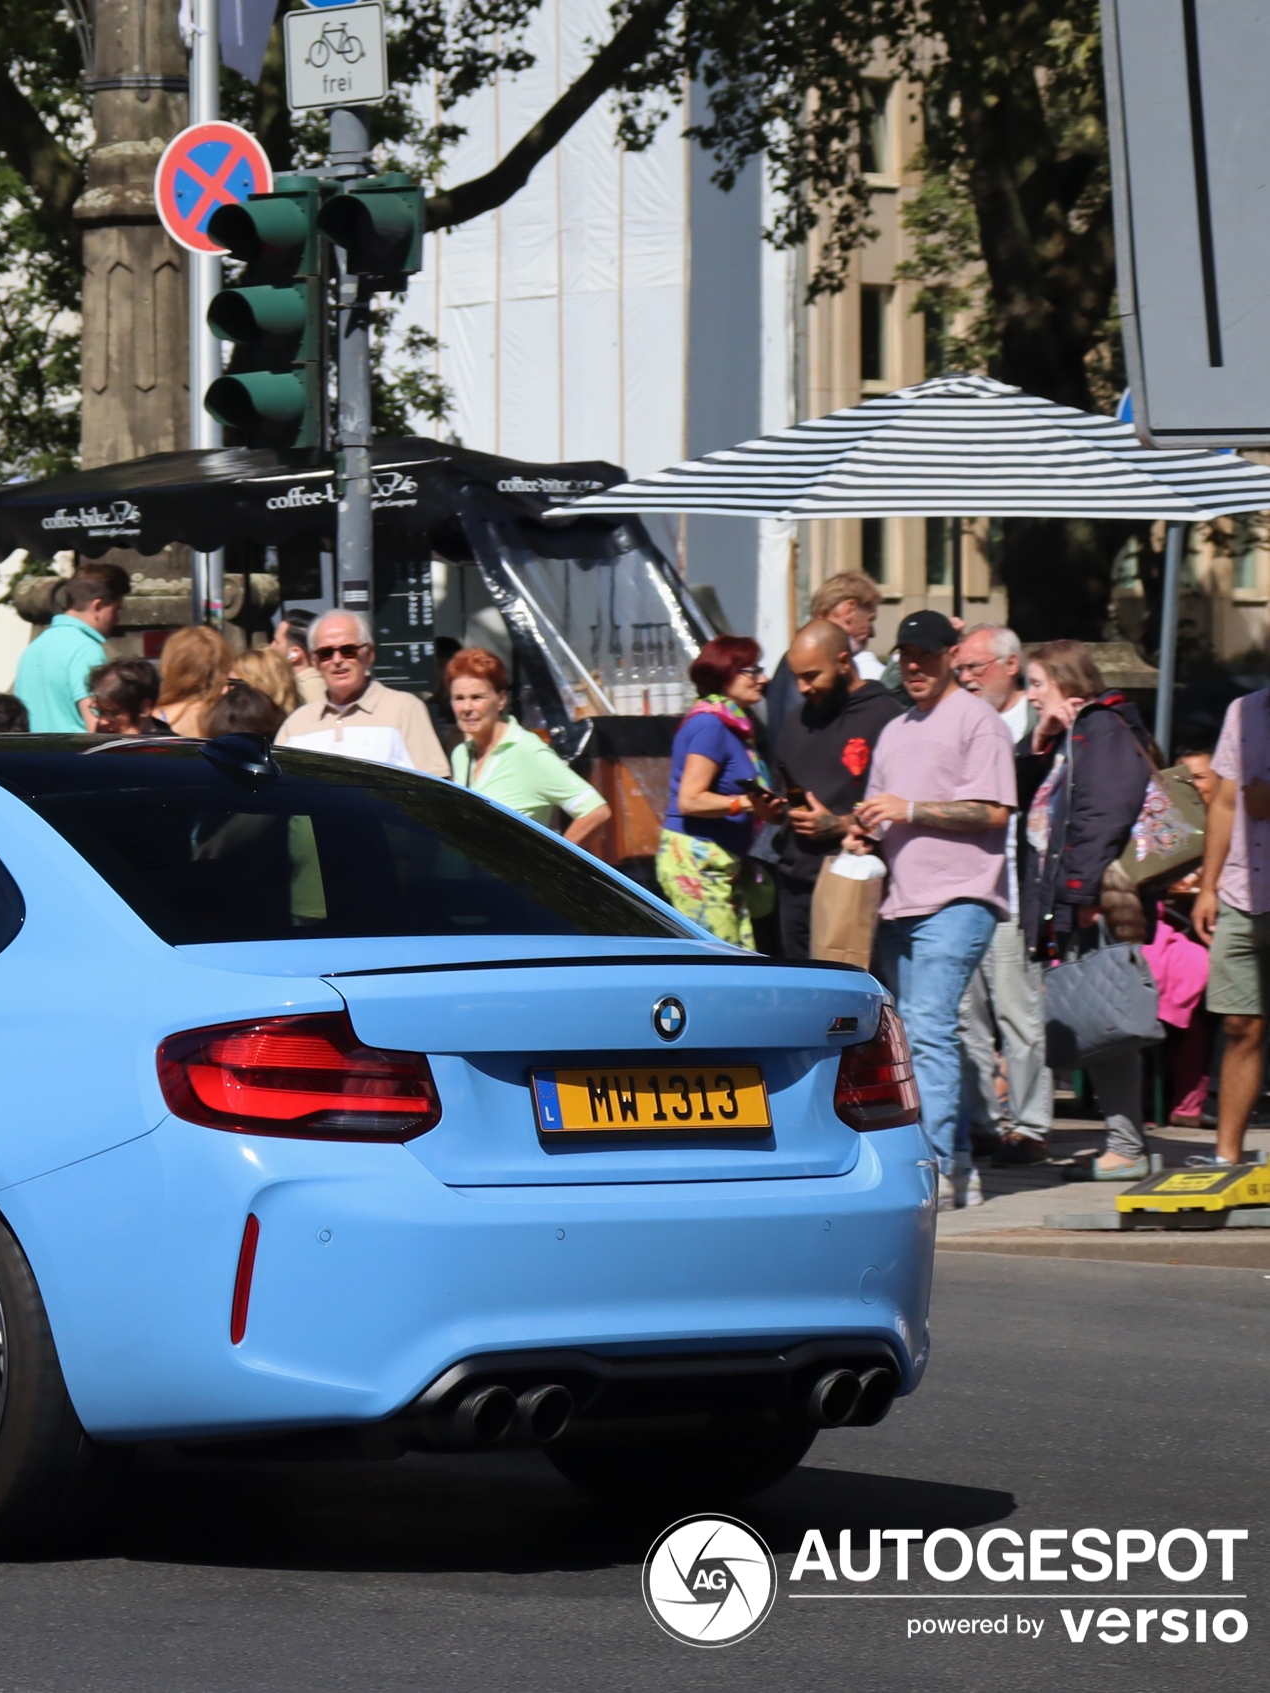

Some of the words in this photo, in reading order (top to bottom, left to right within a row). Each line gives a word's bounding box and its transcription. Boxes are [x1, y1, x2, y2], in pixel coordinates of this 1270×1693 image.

[322, 71, 352, 94] frei
[266, 483, 339, 510] coffee-b
[41, 506, 110, 530] coffee-bike
[586, 1075, 639, 1122] MW
[648, 1074, 739, 1121] 1313
[544, 1106, 556, 1122] L
